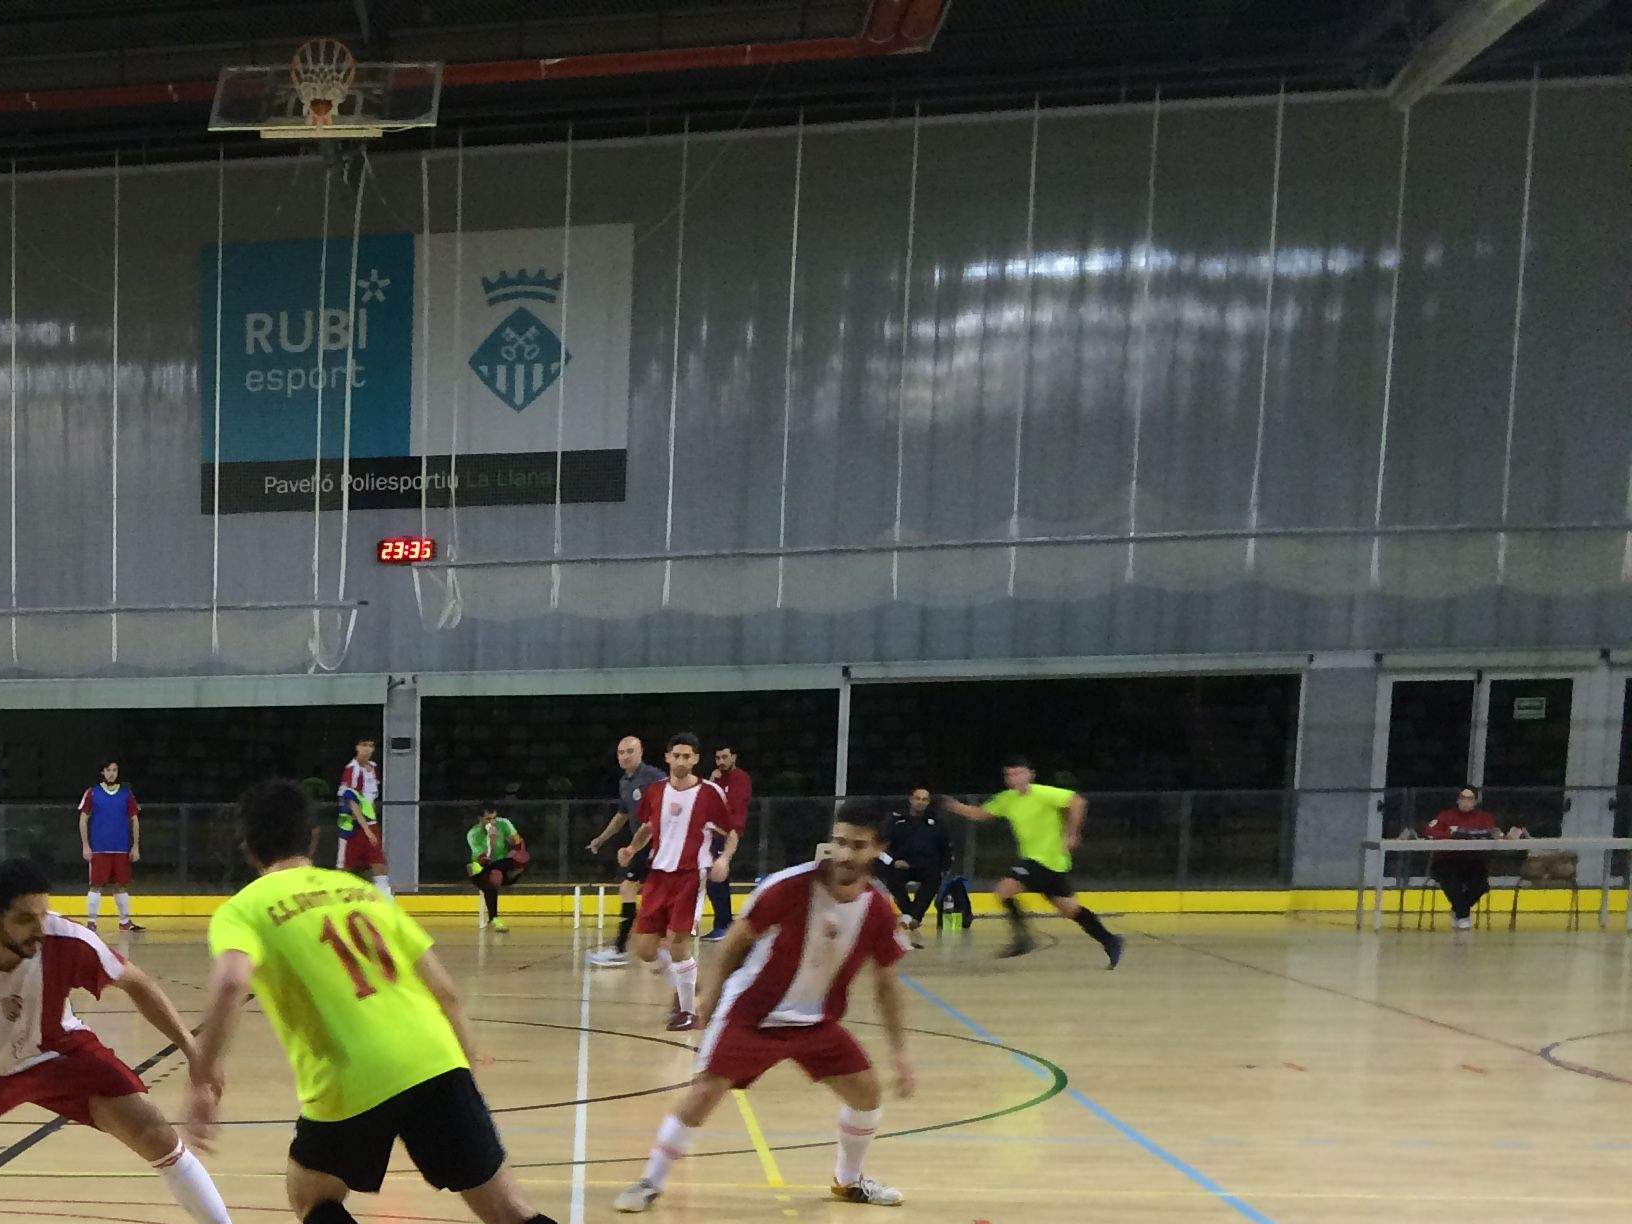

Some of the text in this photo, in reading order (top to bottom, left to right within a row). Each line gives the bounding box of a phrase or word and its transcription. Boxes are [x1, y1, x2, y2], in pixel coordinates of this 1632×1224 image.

[245, 359, 367, 398] esport
[264, 473, 334, 494] Paveló
[341, 470, 459, 493] Poliesportiu
[381, 541, 431, 560] 23:35
[320, 910, 399, 1001] 10
